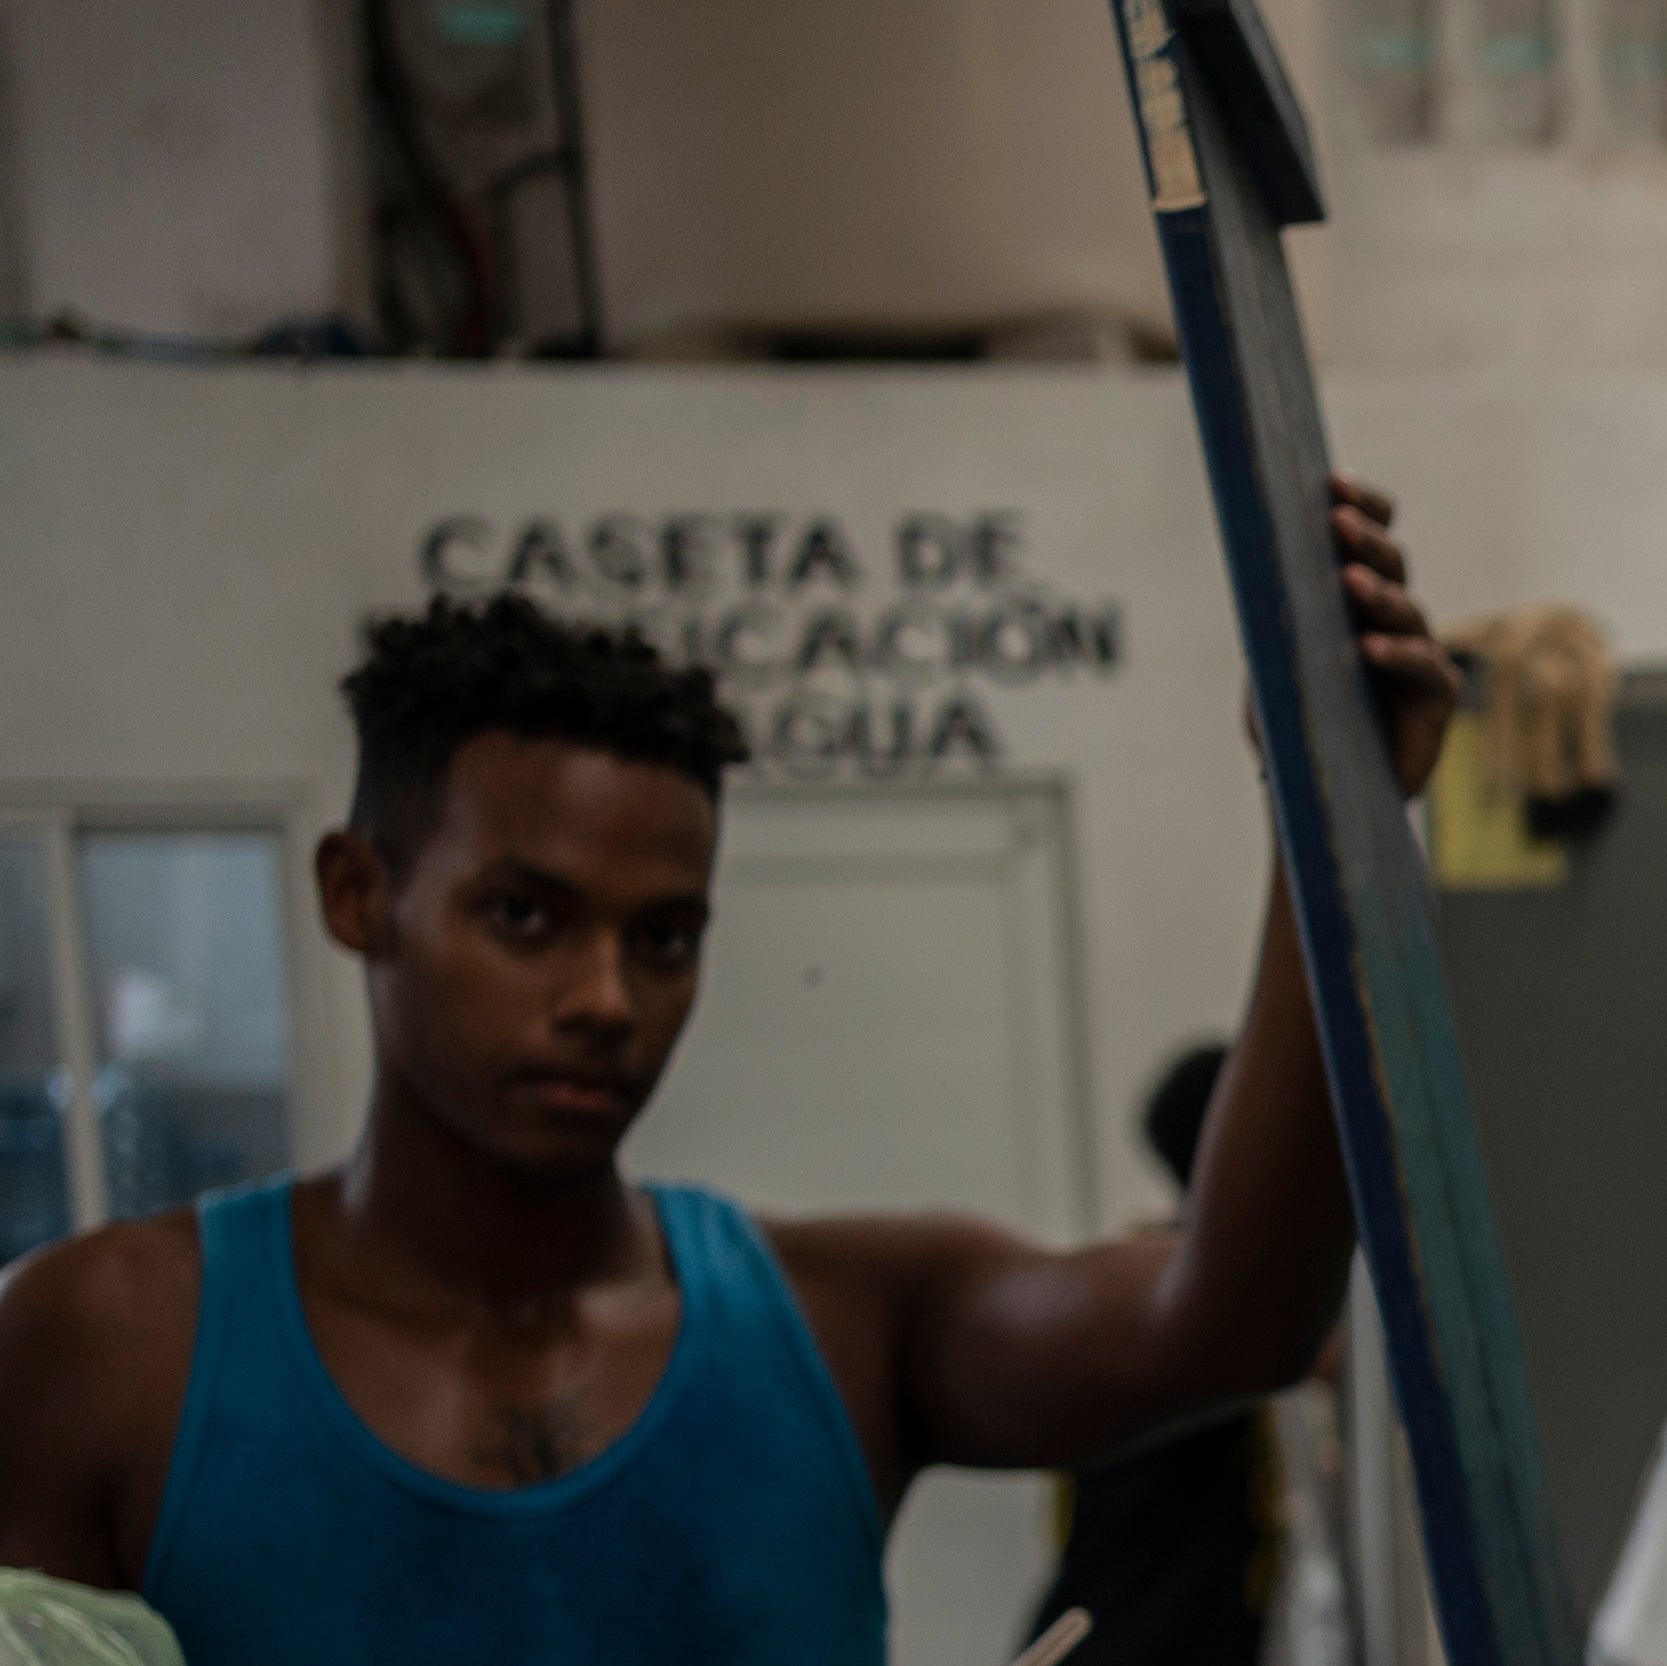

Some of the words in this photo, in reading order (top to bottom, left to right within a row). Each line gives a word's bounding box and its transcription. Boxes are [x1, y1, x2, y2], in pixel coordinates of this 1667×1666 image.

[420, 508, 858, 597] CASETA
[898, 508, 1030, 592] DE
[768, 695, 1003, 780] GUA
